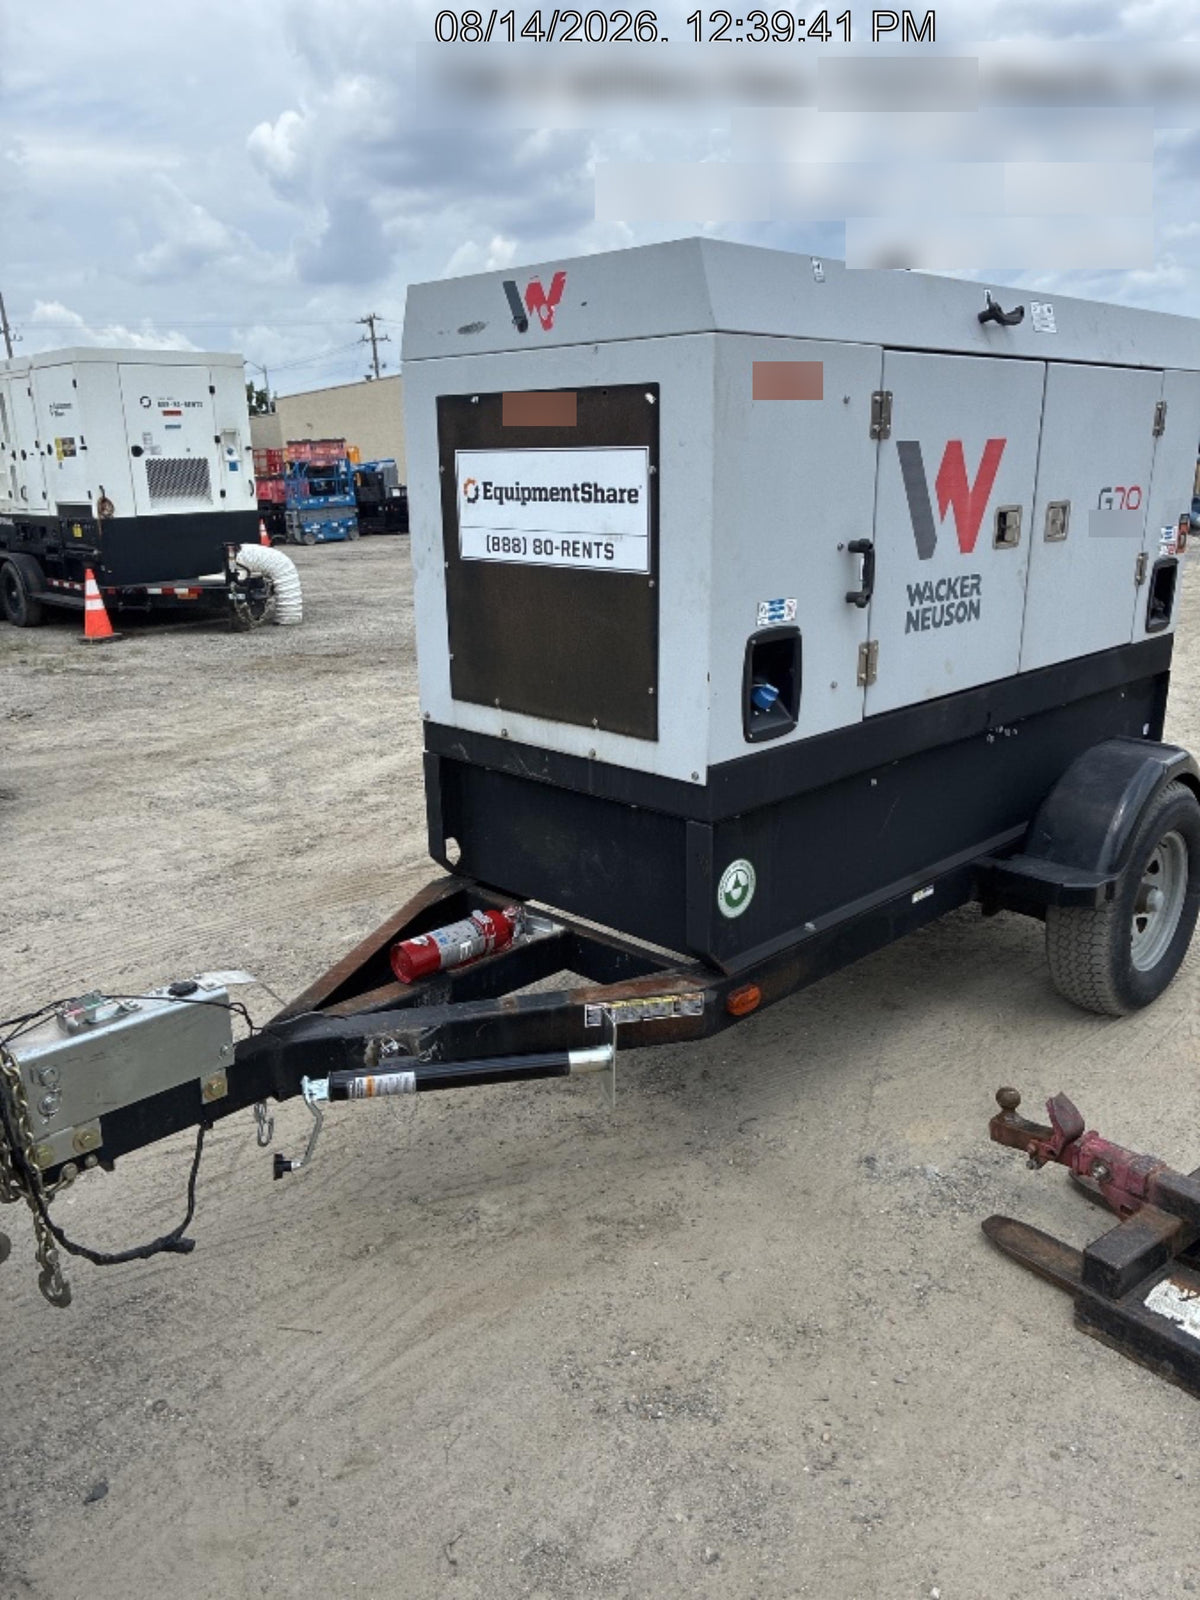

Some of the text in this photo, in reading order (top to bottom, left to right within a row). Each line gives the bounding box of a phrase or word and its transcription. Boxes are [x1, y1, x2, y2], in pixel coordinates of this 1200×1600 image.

[482, 481, 640, 505] EquipmentShare
[1098, 485, 1142, 510] G70
[486, 535, 614, 560] (888) 80-RENTS
[906, 574, 982, 607] WACKER
[905, 599, 981, 634] NEUSON
